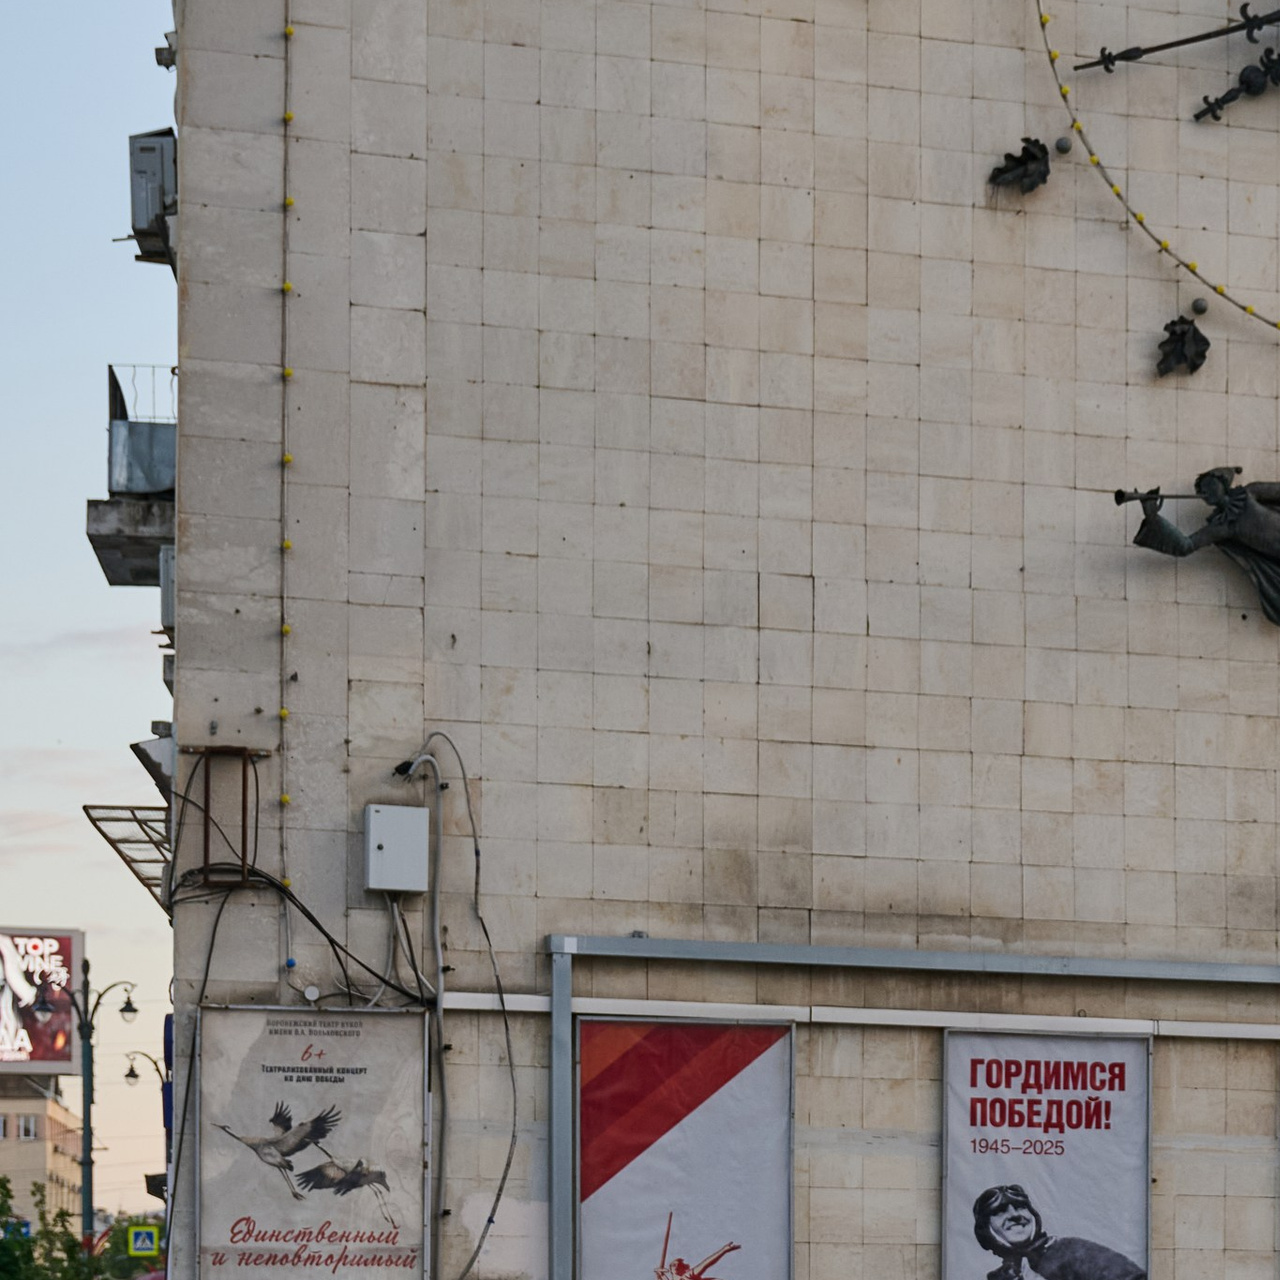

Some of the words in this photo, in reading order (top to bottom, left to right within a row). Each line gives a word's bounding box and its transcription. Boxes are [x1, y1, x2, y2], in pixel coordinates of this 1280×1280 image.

[301, 1043, 327, 1061] 6+
[969, 1057, 1126, 1094] ГОРДИМСЯ
[969, 1096, 1112, 1133] ПОБЕДОЙ!
[230, 1216, 400, 1245] Единственный
[211, 1252, 229, 1266] и
[238, 1244, 418, 1274] неповторимый
